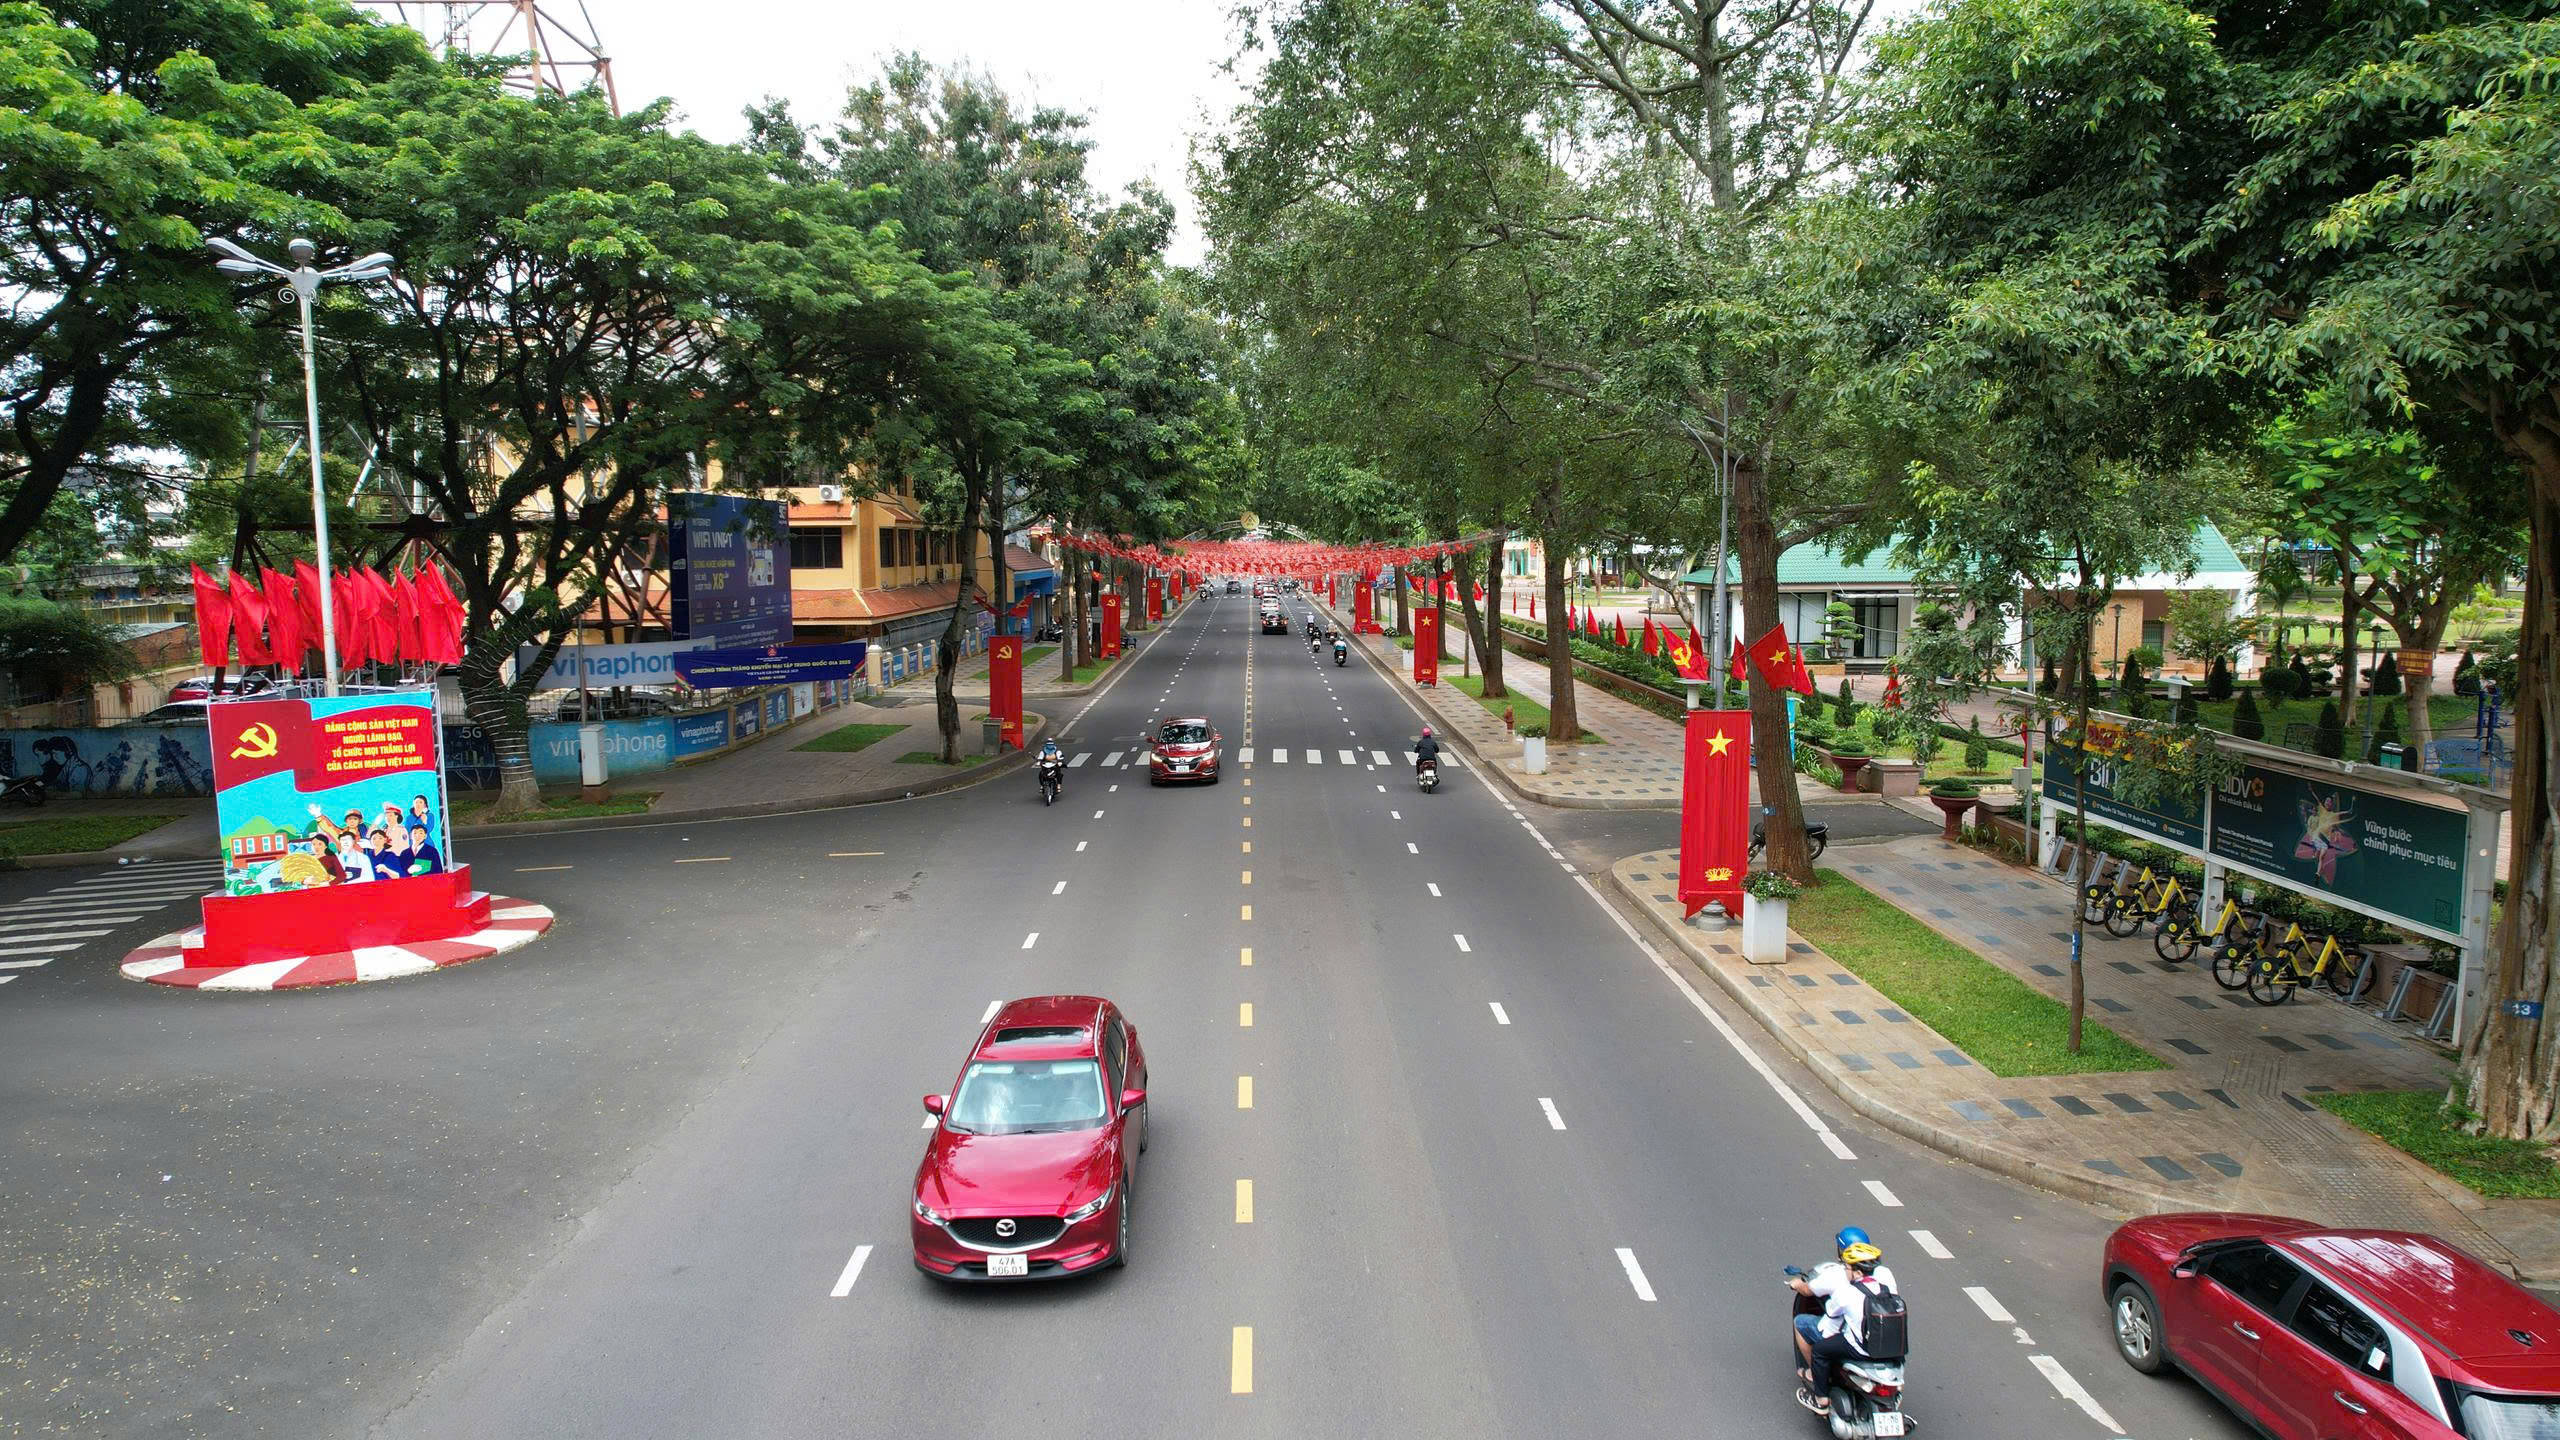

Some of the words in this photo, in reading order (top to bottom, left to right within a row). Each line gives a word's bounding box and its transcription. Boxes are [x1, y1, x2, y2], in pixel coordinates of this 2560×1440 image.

[692, 532, 711, 548] WIFI
[712, 532, 733, 548] VNPT
[552, 652, 674, 679] vinaphon
[325, 722, 346, 733] ĐẢNG
[347, 721, 367, 732] CỘNG
[369, 718, 384, 730] SẢN
[385, 719, 400, 730] VIỆT
[401, 718, 418, 727] NAM
[462, 727, 482, 738] 5G
[343, 734, 366, 744] NGƯỜI
[367, 733, 386, 743] LÃNH
[387, 732, 404, 742] ĐẠO,
[550, 733, 666, 757] vinphone
[343, 746, 363, 757] CHỨC
[364, 747, 378, 757] MỌI
[380, 743, 403, 754] THẮNG
[404, 743, 416, 754] LỢI
[326, 760, 342, 771] CỦA
[343, 760, 363, 770] CÁCH
[364, 759, 386, 769] MẠNG
[387, 756, 402, 768] VIỆT
[403, 755, 423, 765] NAM!
[2090, 757, 2118, 789] BID
[2219, 776, 2252, 798] BIDV
[2365, 820, 2387, 838] Vững
[2389, 826, 2412, 842] bước
[2364, 836, 2388, 852] chinh
[2390, 843, 2413, 860] phục
[2414, 850, 2435, 866] mục
[2437, 855, 2457, 871] tiêu
[999, 1257, 1016, 1266] 47A
